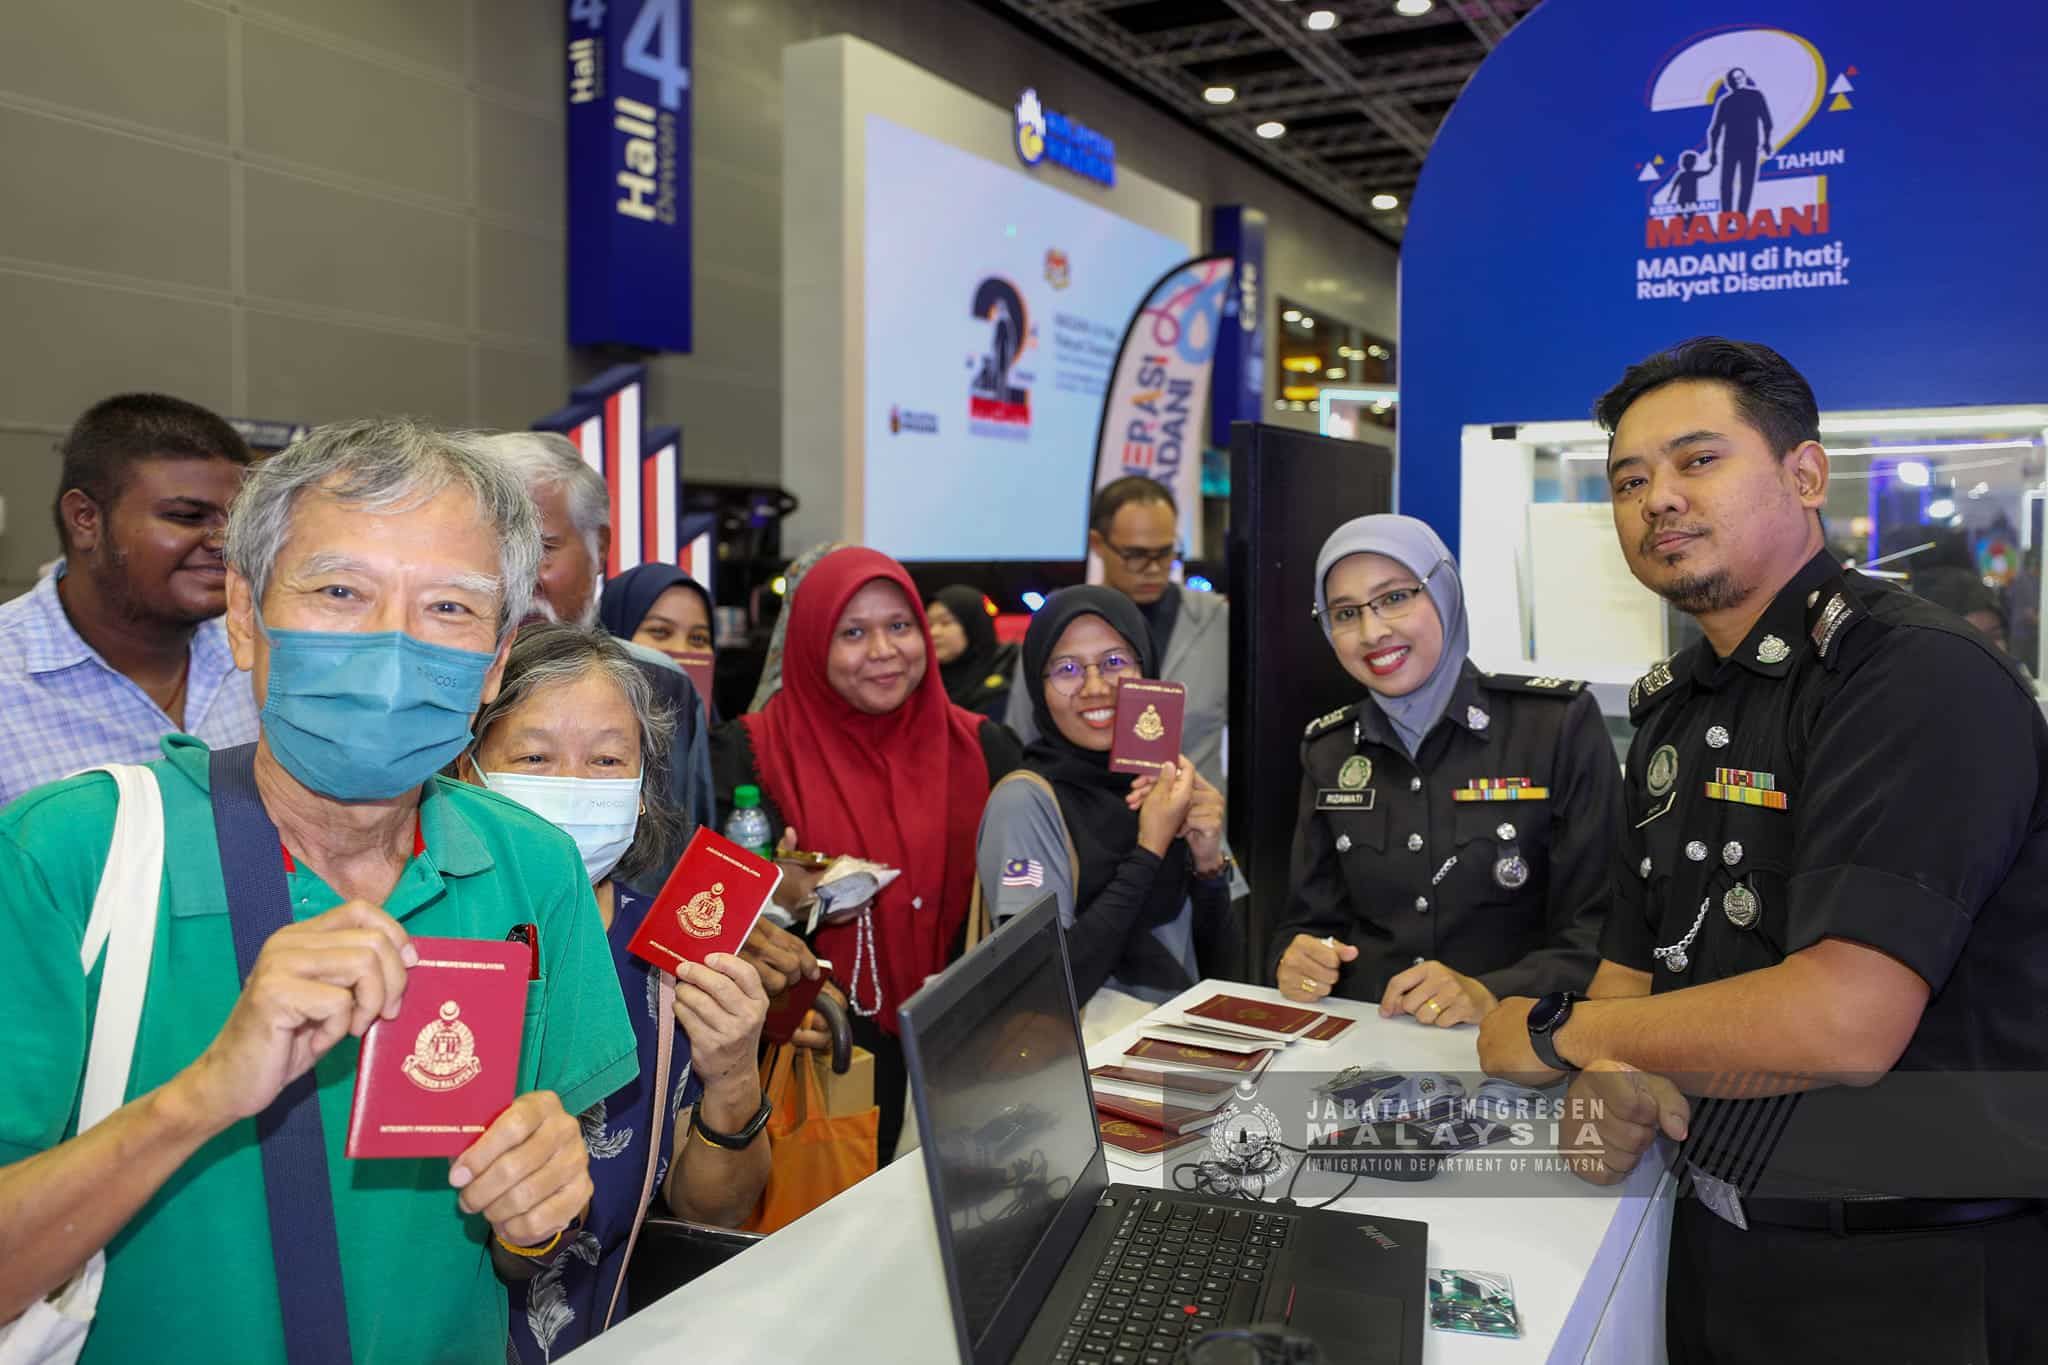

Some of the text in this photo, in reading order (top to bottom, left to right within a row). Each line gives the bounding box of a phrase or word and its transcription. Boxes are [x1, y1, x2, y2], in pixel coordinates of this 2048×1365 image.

[568, 38, 595, 104] Hall
[613, 97, 656, 222] Hall
[1776, 149, 1845, 170] TAHUN
[1645, 202, 1829, 249] MADANI
[1637, 240, 1850, 281] MADANI di hati,
[1637, 265, 1849, 303] Rakyat Disantuni.
[1152, 378, 1194, 488] ADANI
